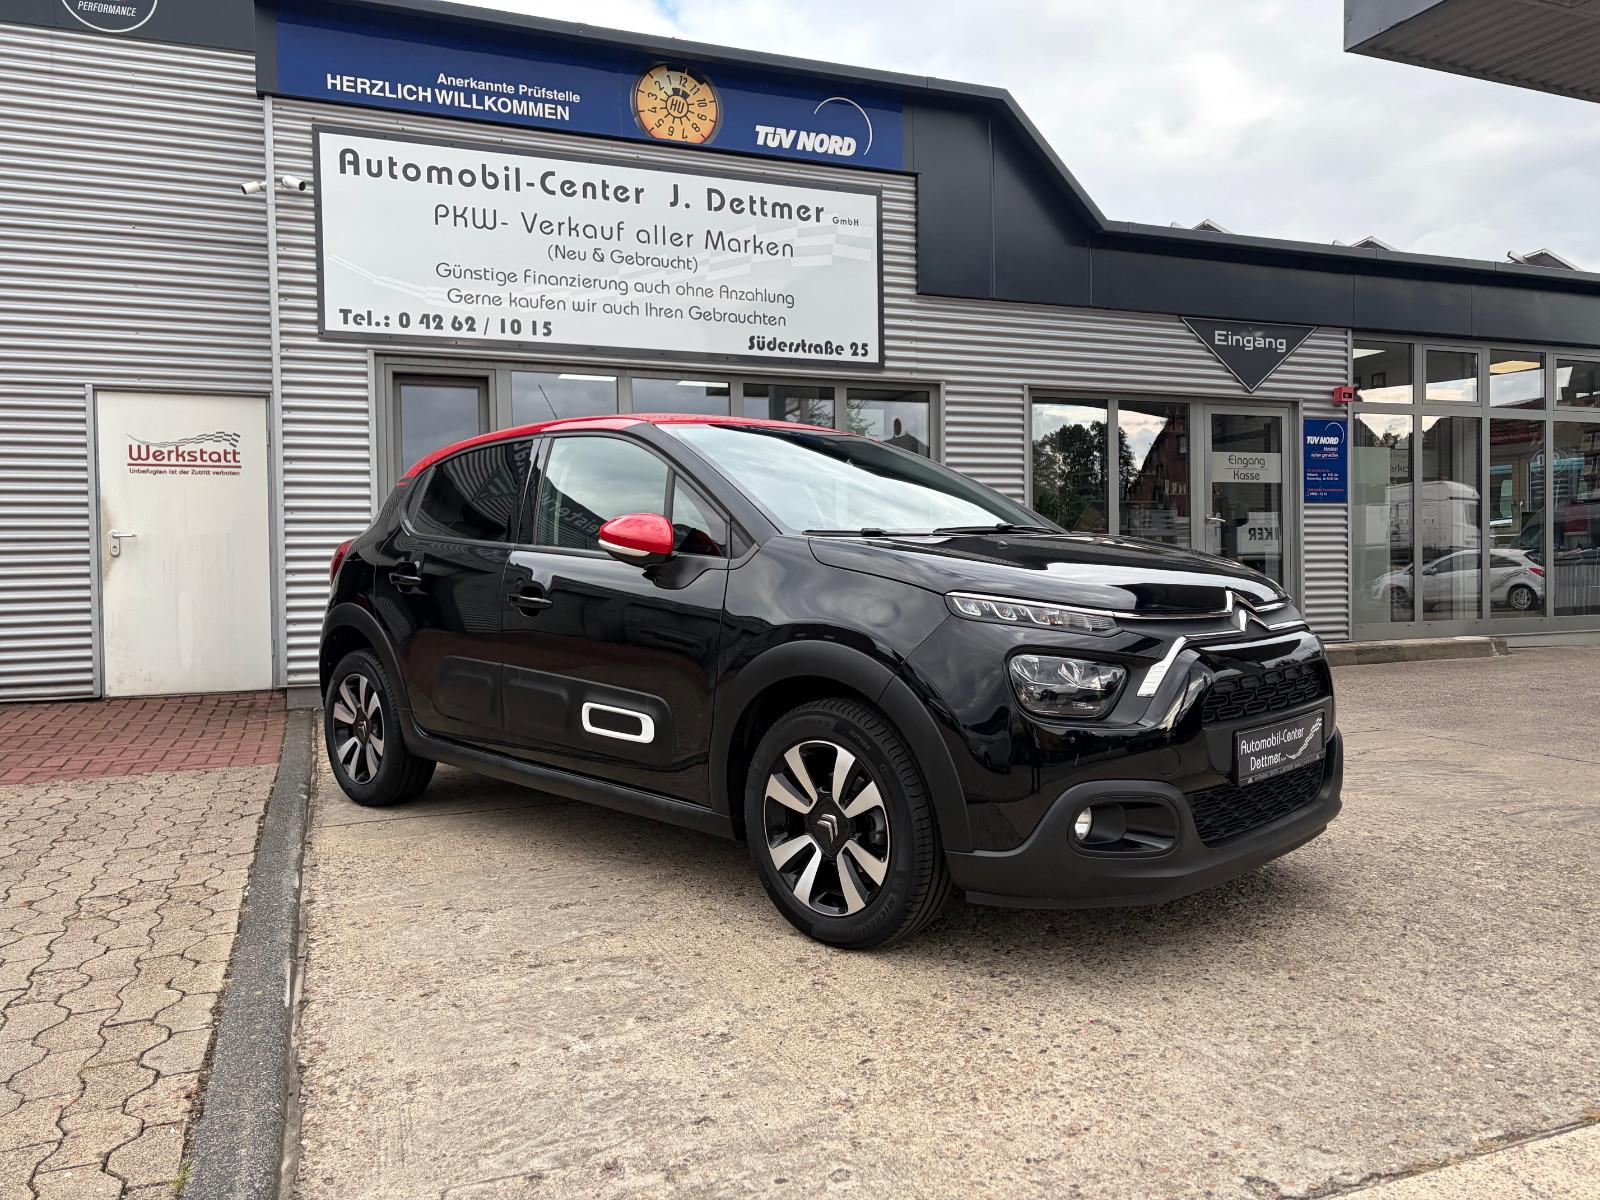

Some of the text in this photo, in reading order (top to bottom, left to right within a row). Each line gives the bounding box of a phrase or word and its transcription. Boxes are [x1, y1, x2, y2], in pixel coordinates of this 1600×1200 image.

[77, 0, 137, 17] PERFORMANCE
[437, 72, 581, 103] Anerkannte Prüfstelle
[654, 80, 665, 91] 2
[679, 75, 688, 88] 12
[326, 73, 570, 121] HERZLICH WILLKOMMEN
[647, 92, 658, 101] 3
[689, 84, 700, 96] 11
[669, 98, 685, 114] HU
[696, 97, 708, 108] 10
[655, 118, 664, 128] 5
[696, 113, 707, 121] 9
[667, 126, 675, 136] 6
[682, 128, 688, 139] 7
[691, 122, 701, 132] 8
[755, 125, 857, 157] TÜV NORD
[338, 147, 859, 227] Automobil-Center J. Dettmer GmbH
[434, 203, 795, 258] PKW- Verkauf aller Marken
[547, 244, 698, 273] (Neu & Gebraucht)
[435, 262, 795, 308] Günstige Finanzierung auch ohne Anzahlung
[447, 288, 786, 327] Gerne kaufen wir auch Ihren Gebrauchten
[339, 308, 390, 328] Tel.:
[450, 315, 476, 333] 62
[748, 336, 869, 357] Süderstraße 25
[1214, 330, 1287, 353] Eingang
[1306, 436, 1339, 445] TÜV NORD
[128, 444, 240, 463] Werkstatt
[1228, 454, 1265, 468] Eingang
[129, 467, 167, 476] Unbefugten
[191, 468, 211, 476] Zutritt
[212, 469, 240, 477] verboten
[1233, 469, 1261, 480] Kasse
[1240, 727, 1304, 755] Automobil-Center
[1250, 752, 1281, 772] Dettmer
